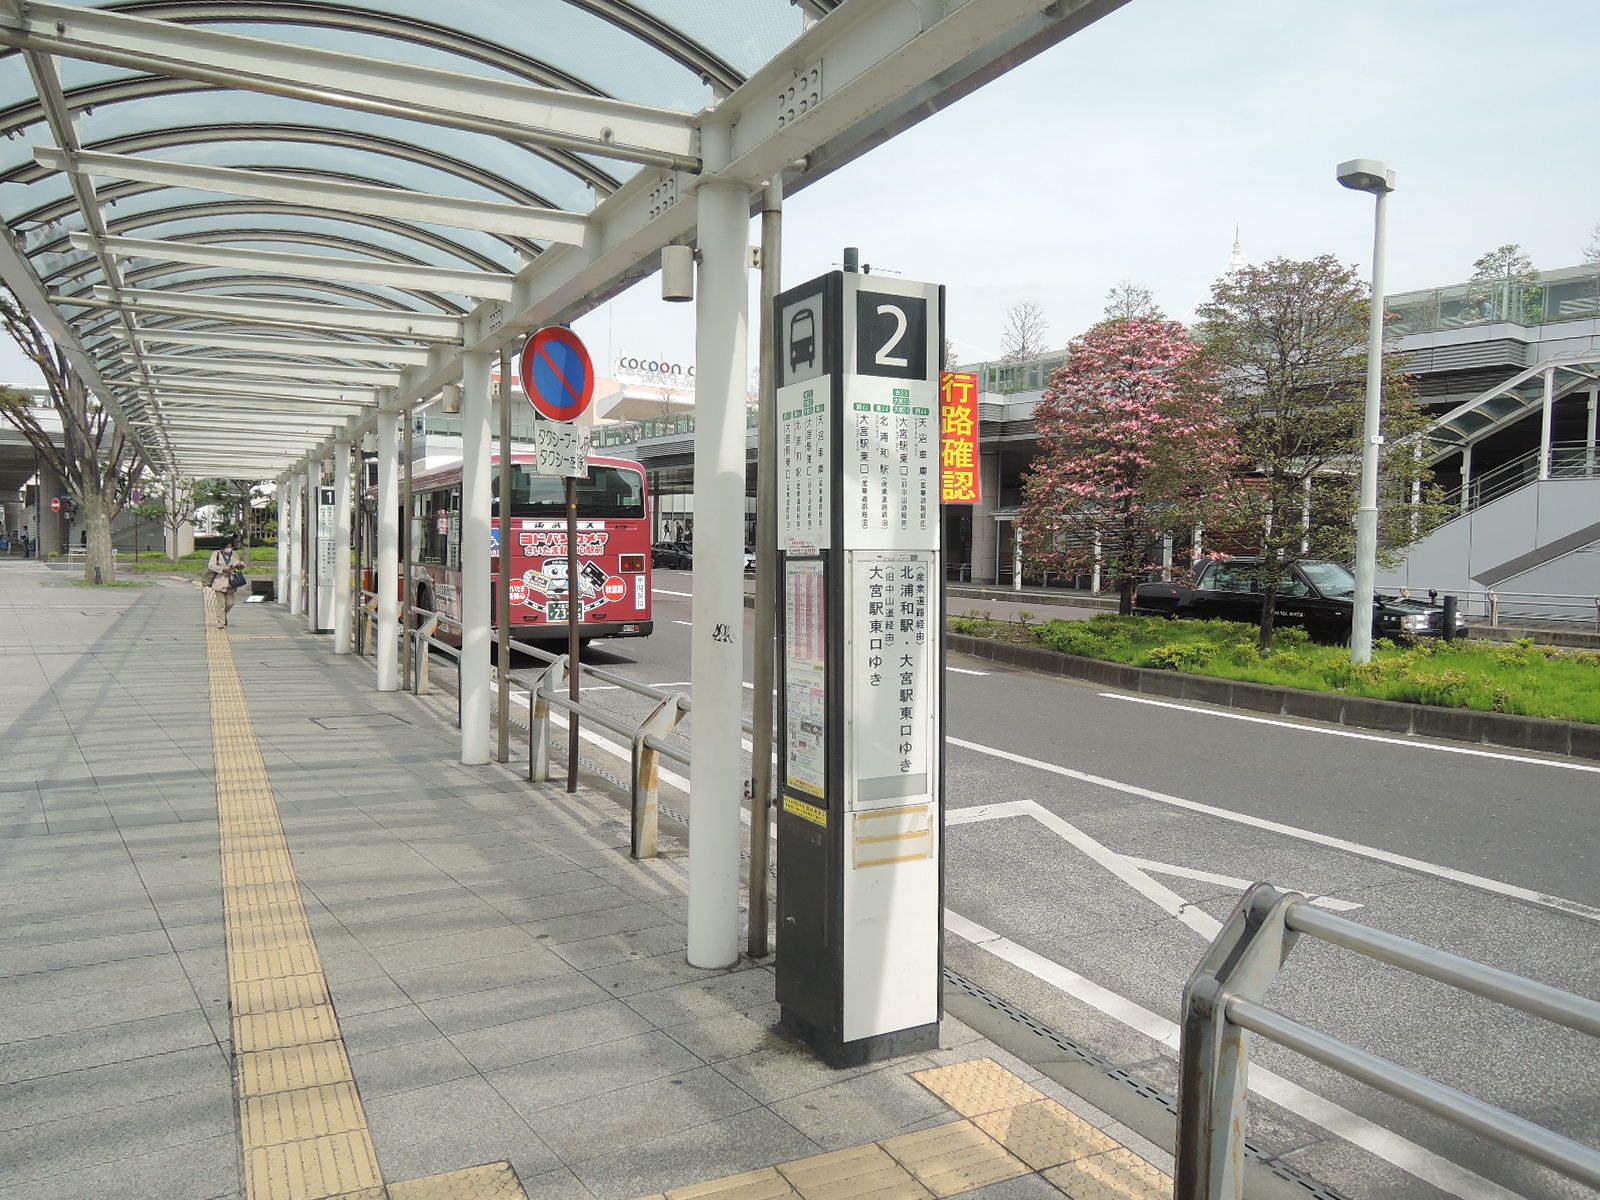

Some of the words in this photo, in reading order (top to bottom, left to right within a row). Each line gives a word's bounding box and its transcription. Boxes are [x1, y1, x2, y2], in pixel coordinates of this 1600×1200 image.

[619, 356, 682, 375] cocoon
[874, 304, 908, 367] 2
[941, 373, 977, 501] 行路確認
[524, 546, 605, 556] さいたま新心駅前
[868, 565, 884, 687] 大宮駅東口ゆき
[899, 566, 914, 773] 北浦和駅・大宮駅東口ゆき
